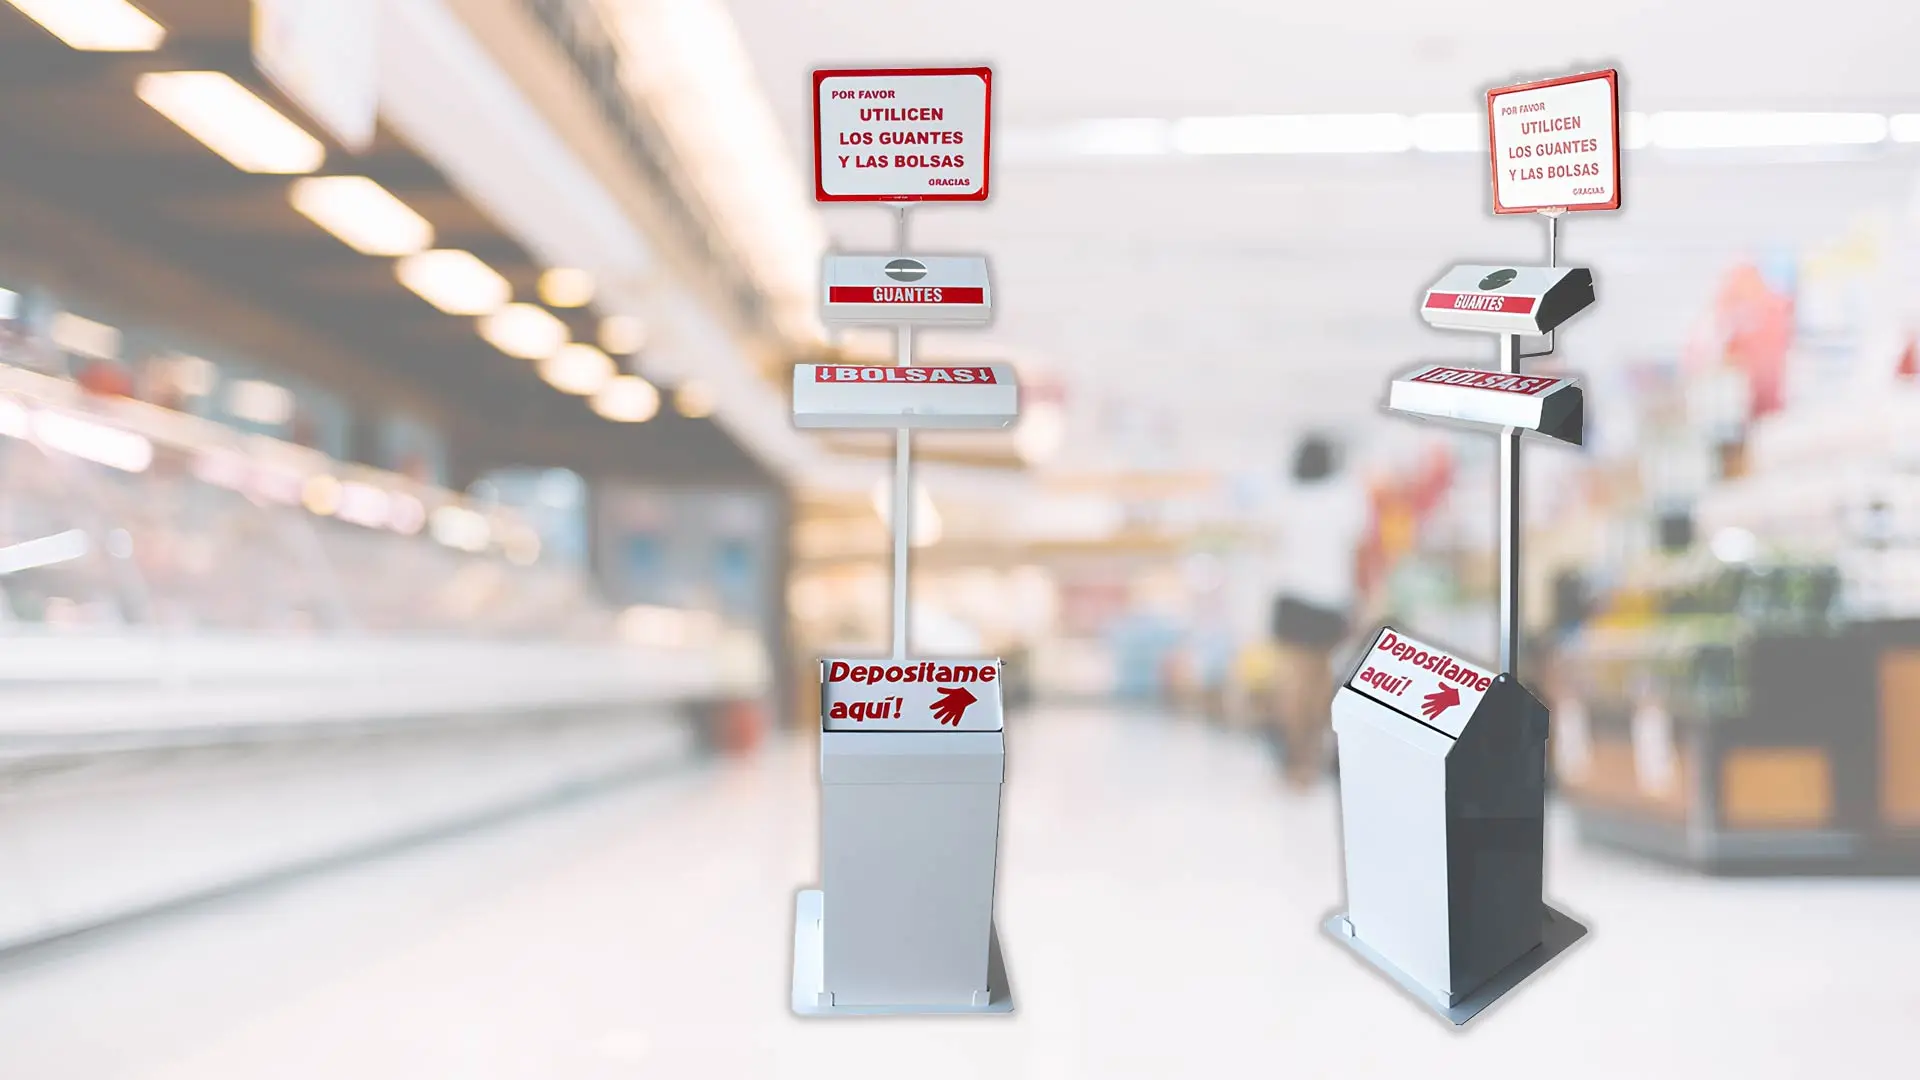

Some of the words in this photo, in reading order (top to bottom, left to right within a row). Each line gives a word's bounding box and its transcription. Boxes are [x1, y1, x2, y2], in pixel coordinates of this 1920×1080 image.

[832, 90, 855, 99] POR
[858, 90, 895, 99] FAVOR
[860, 108, 944, 121] UTILICEN
[1501, 106, 1518, 116] POR
[1519, 102, 1545, 114] FAVOR
[1521, 116, 1581, 135] UTILICEN
[839, 132, 873, 145] LOS
[879, 131, 964, 145] GUANTES
[1509, 146, 1532, 159] LOS
[1536, 138, 1597, 156] GUANTES
[838, 155, 850, 168] Y
[855, 155, 889, 168] LAS
[894, 155, 965, 168] BOLSAS
[1509, 169, 1517, 181] Y
[1520, 167, 1543, 180] LAS
[1548, 162, 1599, 179] BOLSAS
[928, 178, 970, 186] GRACIAS
[1572, 187, 1605, 196] GRACIAS
[873, 287, 943, 302] GUANTES
[1454, 294, 1505, 311] GUANTES
[836, 368, 975, 383] BOLSAS
[1432, 370, 1535, 392] BOLSAS
[1377, 633, 1491, 692] Depositame
[829, 661, 996, 685] Depositame
[1359, 666, 1413, 697] aquí!
[829, 696, 903, 722] aquí!
